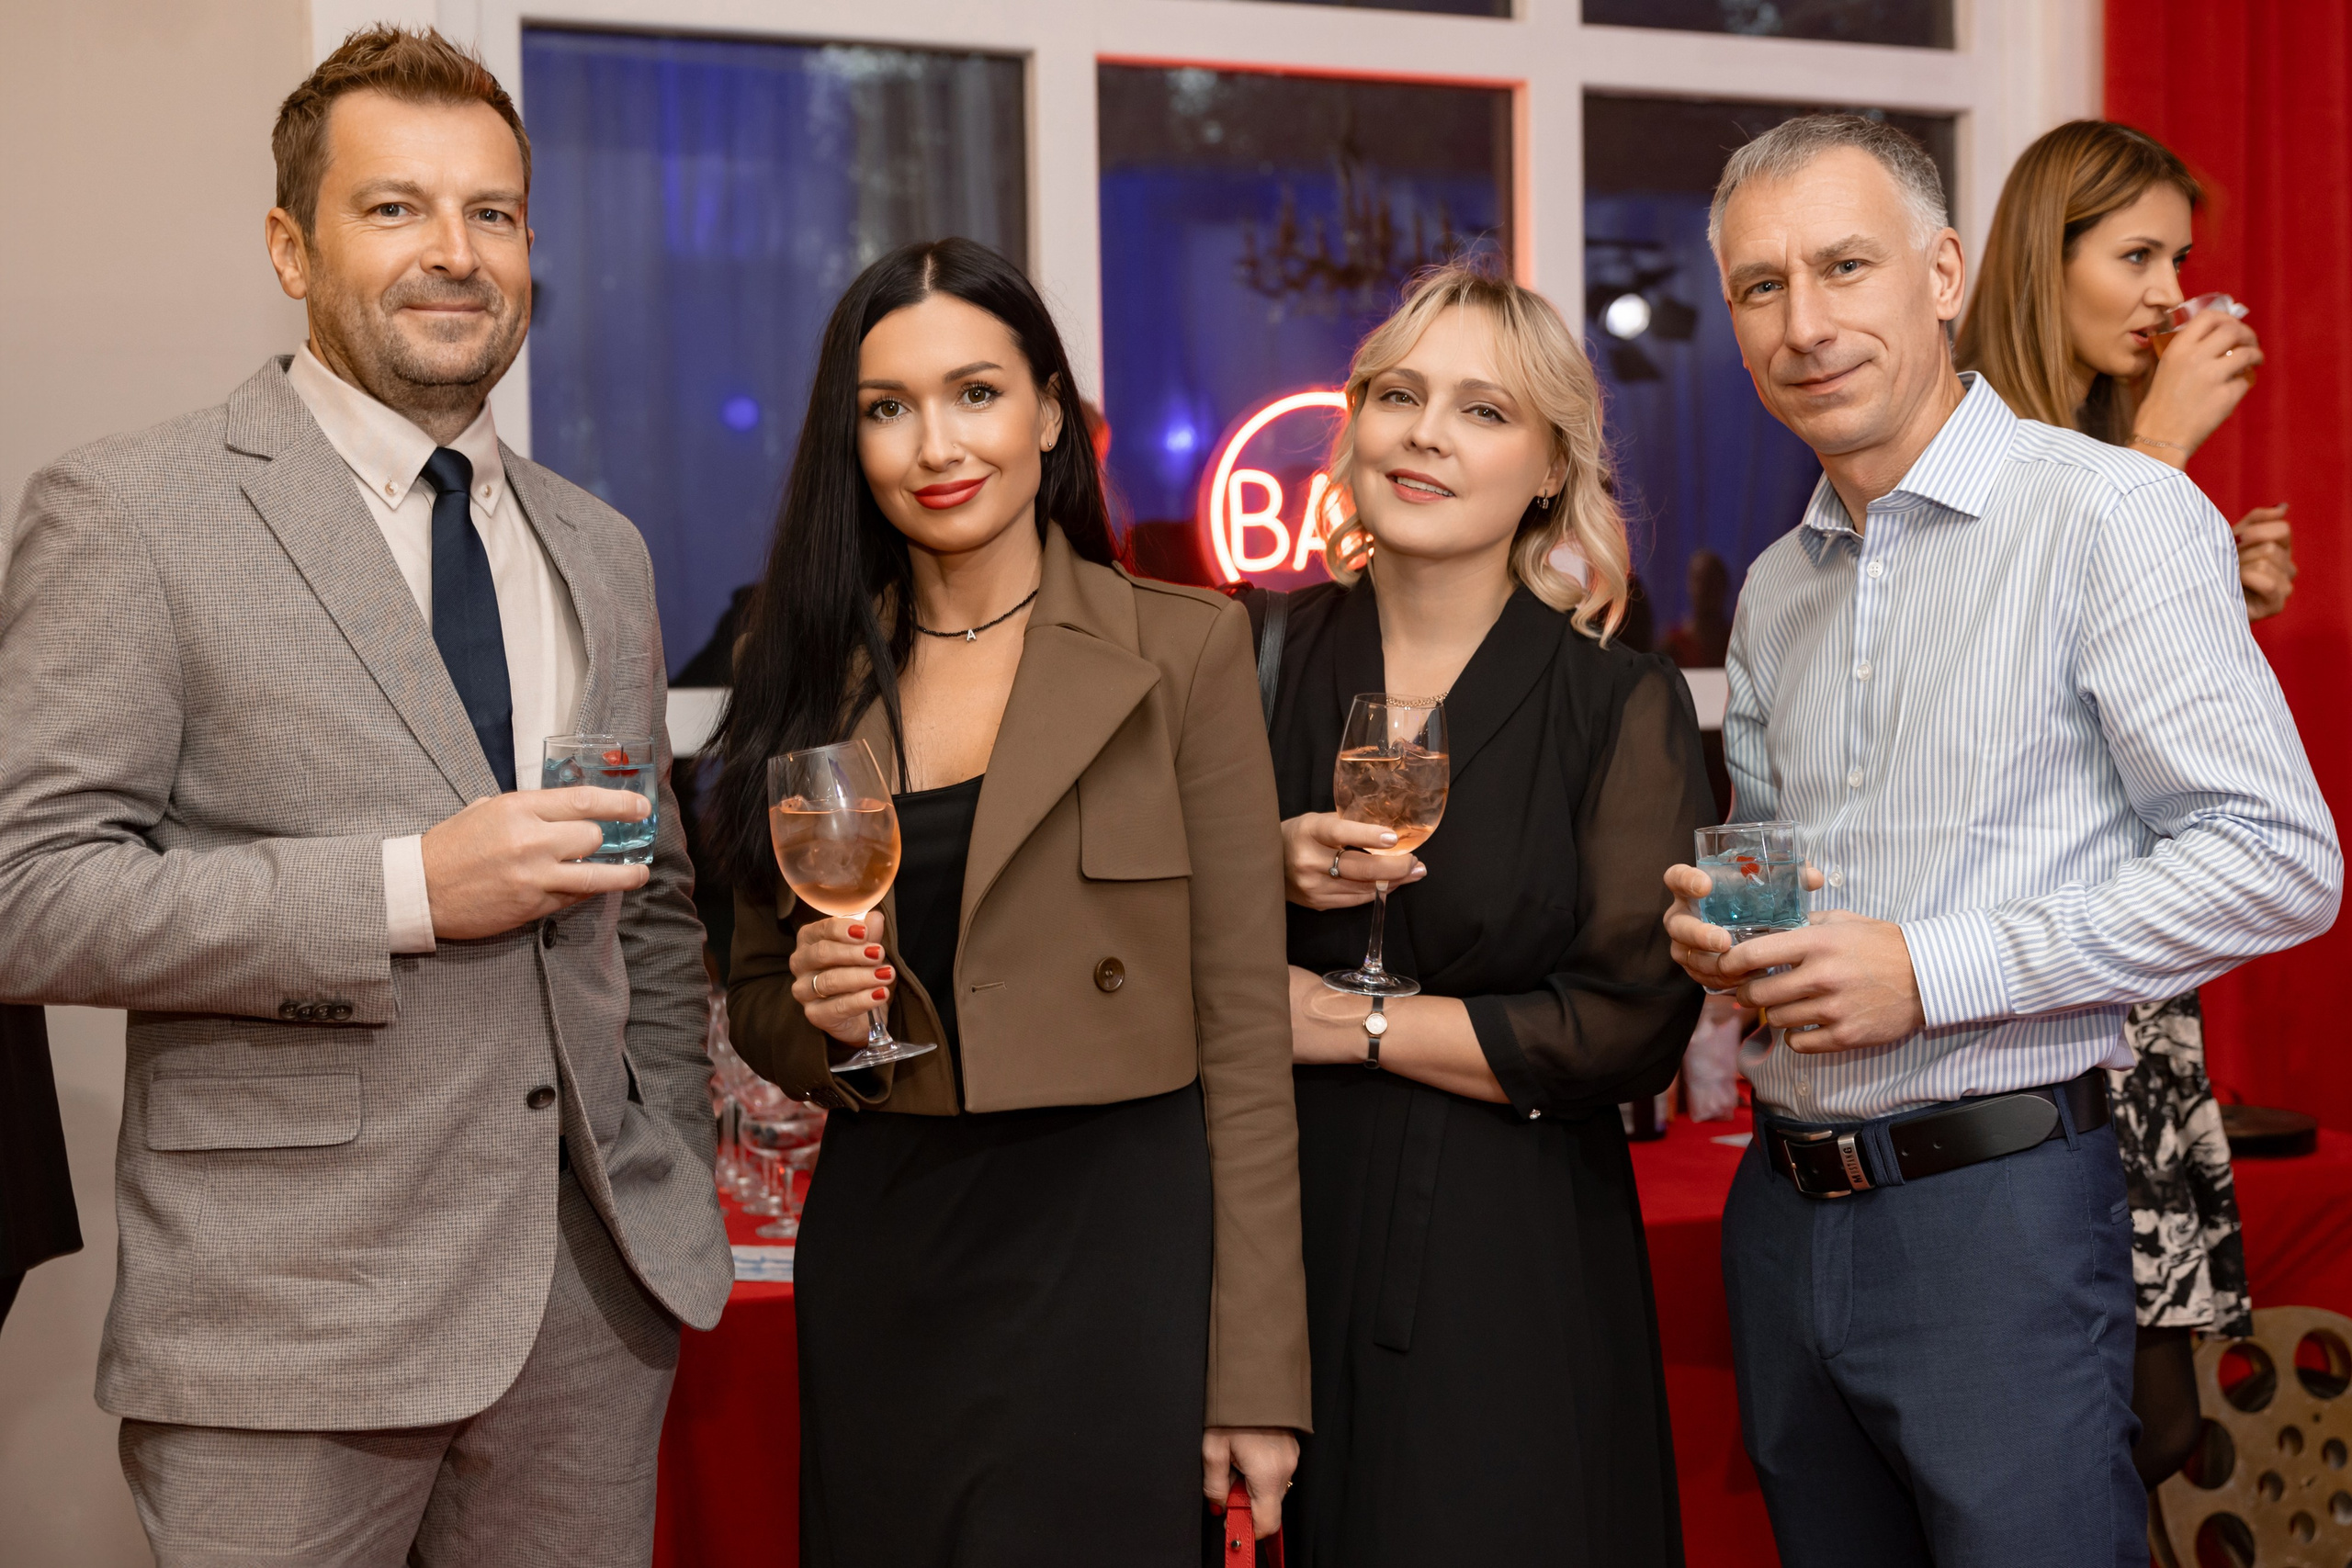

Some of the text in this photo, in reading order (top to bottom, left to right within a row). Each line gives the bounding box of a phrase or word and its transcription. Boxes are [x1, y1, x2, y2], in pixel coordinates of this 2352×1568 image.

[1228, 468, 1362, 572] BA
[966, 628, 977, 643] A
[1843, 1146, 1864, 1184] MUSTANG
